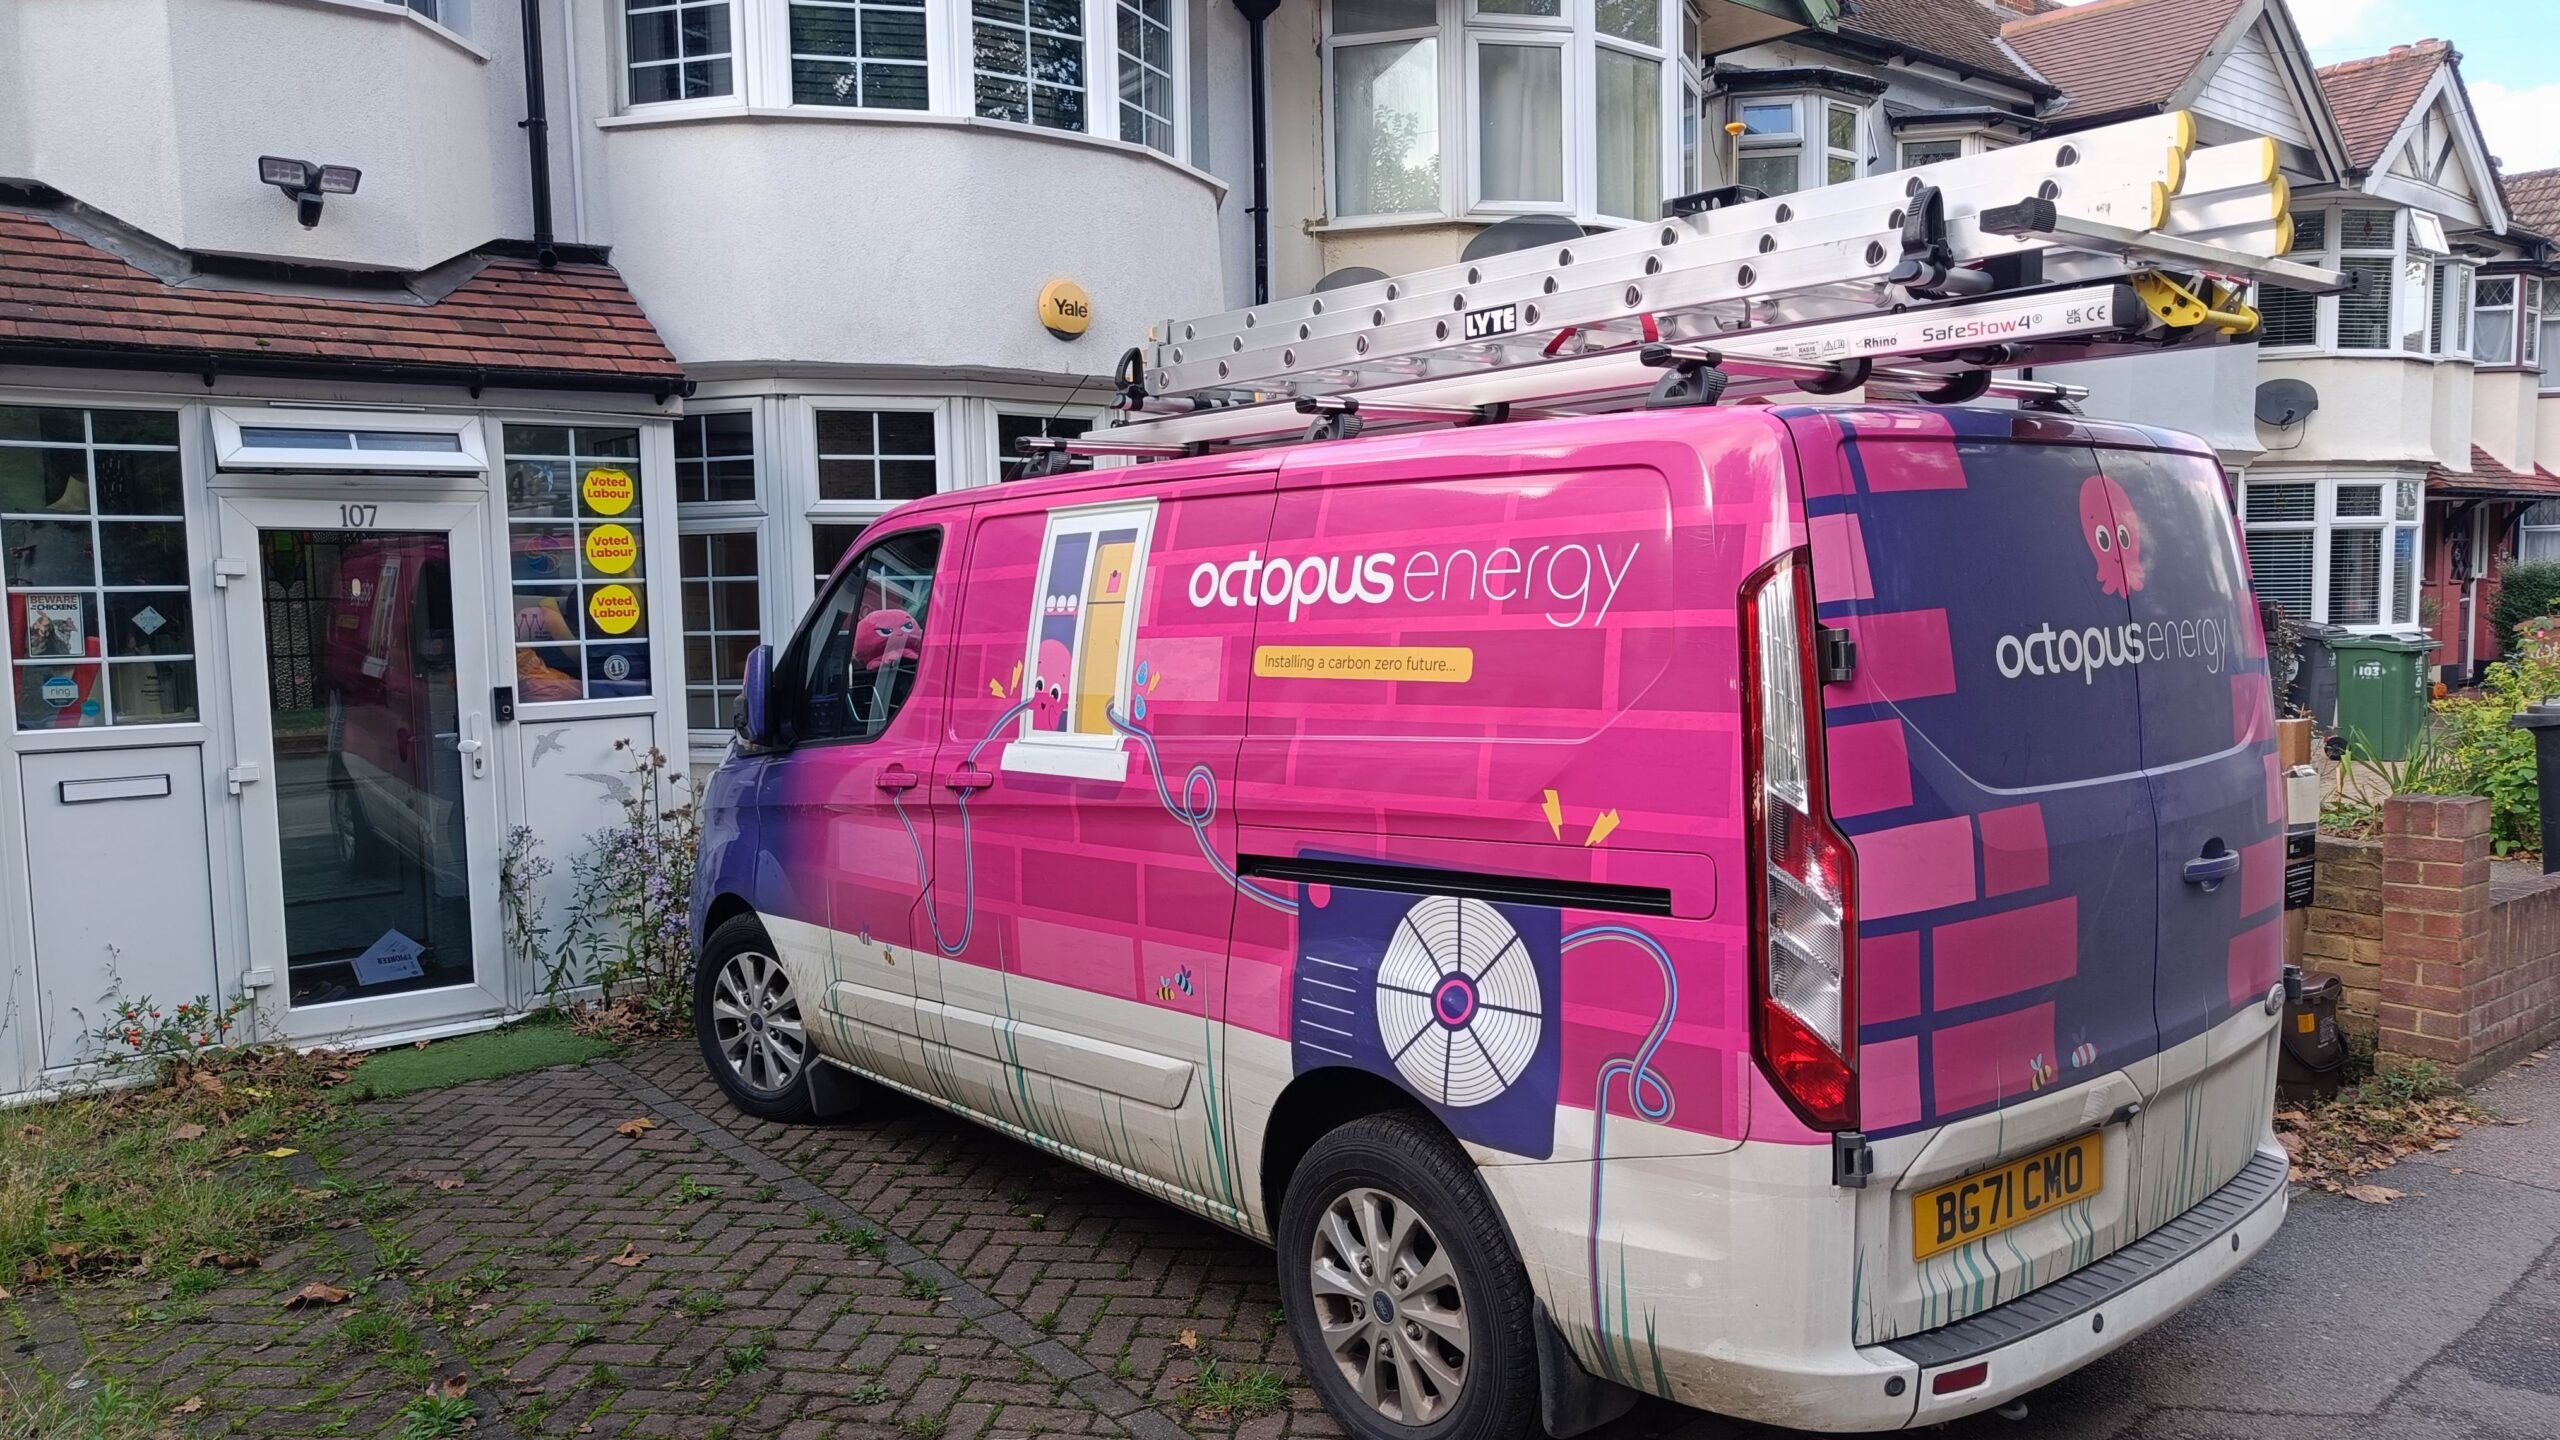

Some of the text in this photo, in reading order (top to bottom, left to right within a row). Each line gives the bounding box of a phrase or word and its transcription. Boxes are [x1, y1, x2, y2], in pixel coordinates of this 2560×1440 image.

[1054, 297, 1088, 318] Yale
[2066, 308, 2080, 317] UK
[1466, 306, 1516, 338] LYTE
[2067, 316, 2081, 325] CA
[1864, 337, 1897, 349] Rhino
[590, 476, 627, 487] Voted
[587, 488, 631, 499] Labour
[340, 504, 378, 527] 107
[592, 535, 629, 546] Voted
[590, 547, 633, 558] Labour
[1188, 542, 1640, 628] octopus energy
[30, 595, 78, 604] BEWARE
[596, 596, 632, 606] Voted
[593, 607, 636, 618] Labour
[1995, 618, 2227, 685] octopus energy
[1264, 655, 1456, 672] Installing a carbon zero future...
[2359, 666, 2380, 676] 103
[50, 687, 71, 697] ring
[1936, 1146, 2083, 1245] BG71 CMO
